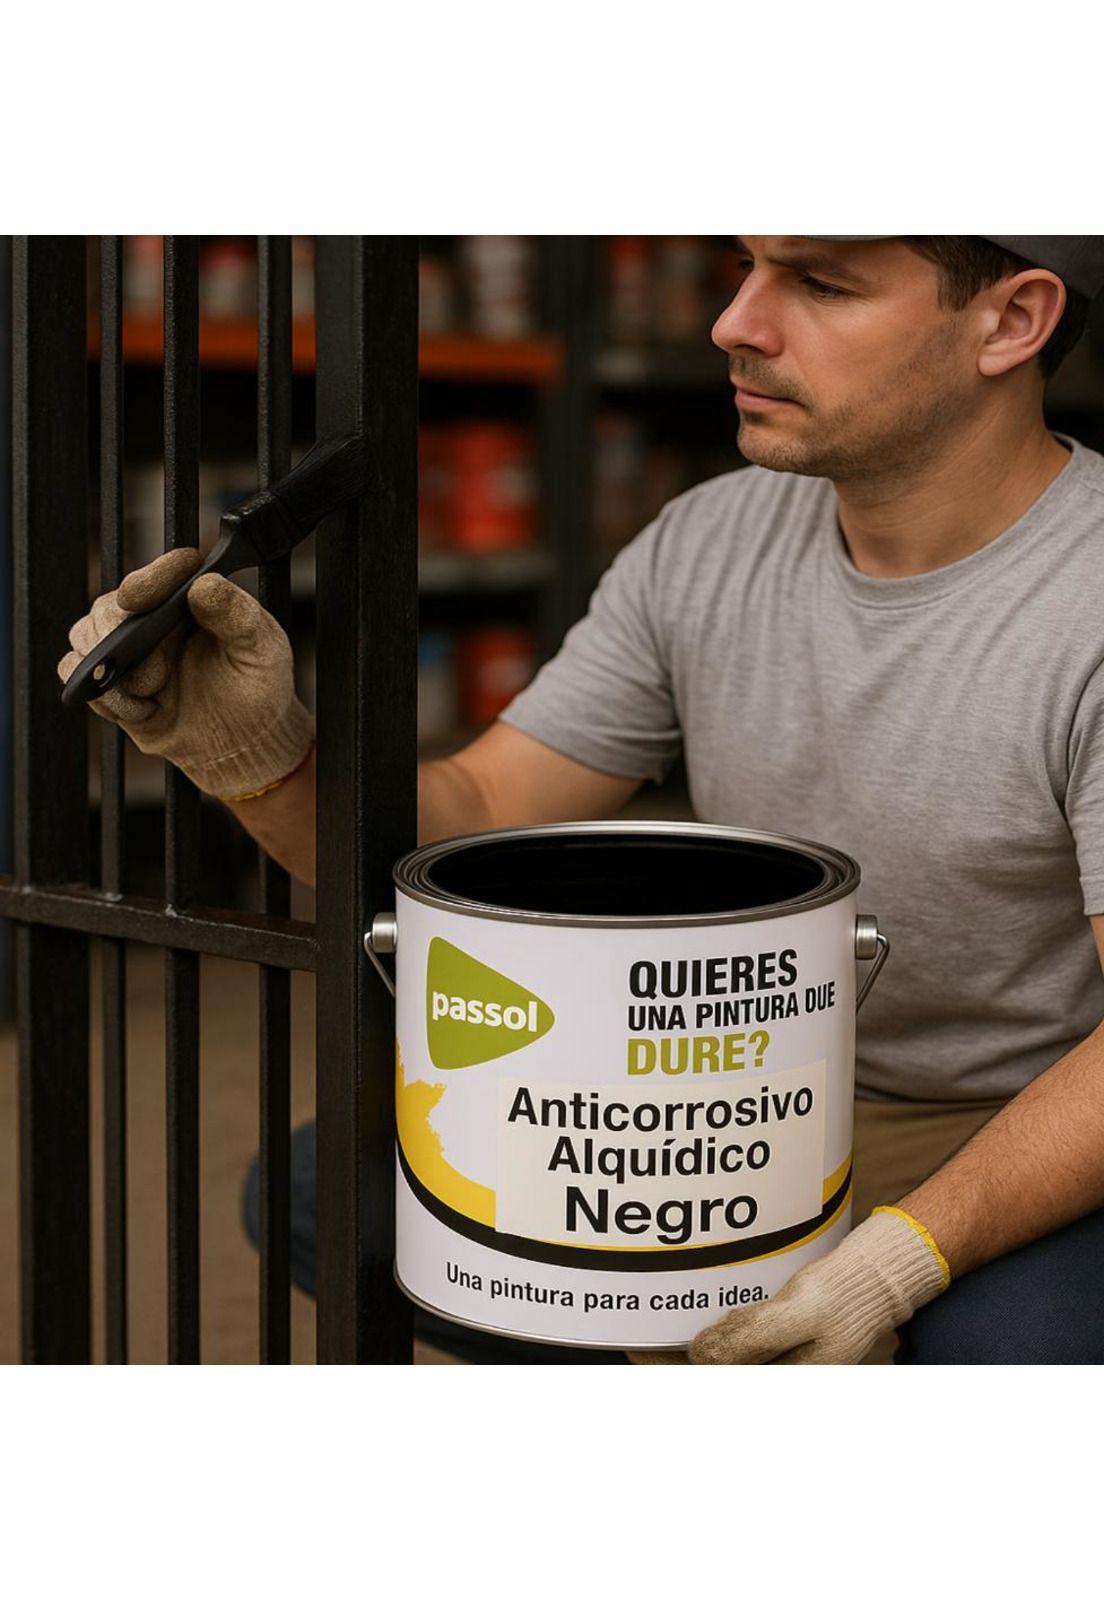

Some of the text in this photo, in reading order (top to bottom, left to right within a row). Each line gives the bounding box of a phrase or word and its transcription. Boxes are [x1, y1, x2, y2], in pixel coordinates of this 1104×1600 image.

[629, 949, 797, 1000] QUIERES
[432, 991, 537, 1032] passol
[628, 1005, 686, 1031] UNA
[696, 996, 799, 1028] PINTURA
[627, 1030, 770, 1075] DURE?
[507, 1086, 814, 1132] Anticorrosivo
[548, 1136, 771, 1184] Alquídico
[565, 1186, 759, 1245] Negro
[446, 1261, 769, 1313] Una pintura para cada idea.
